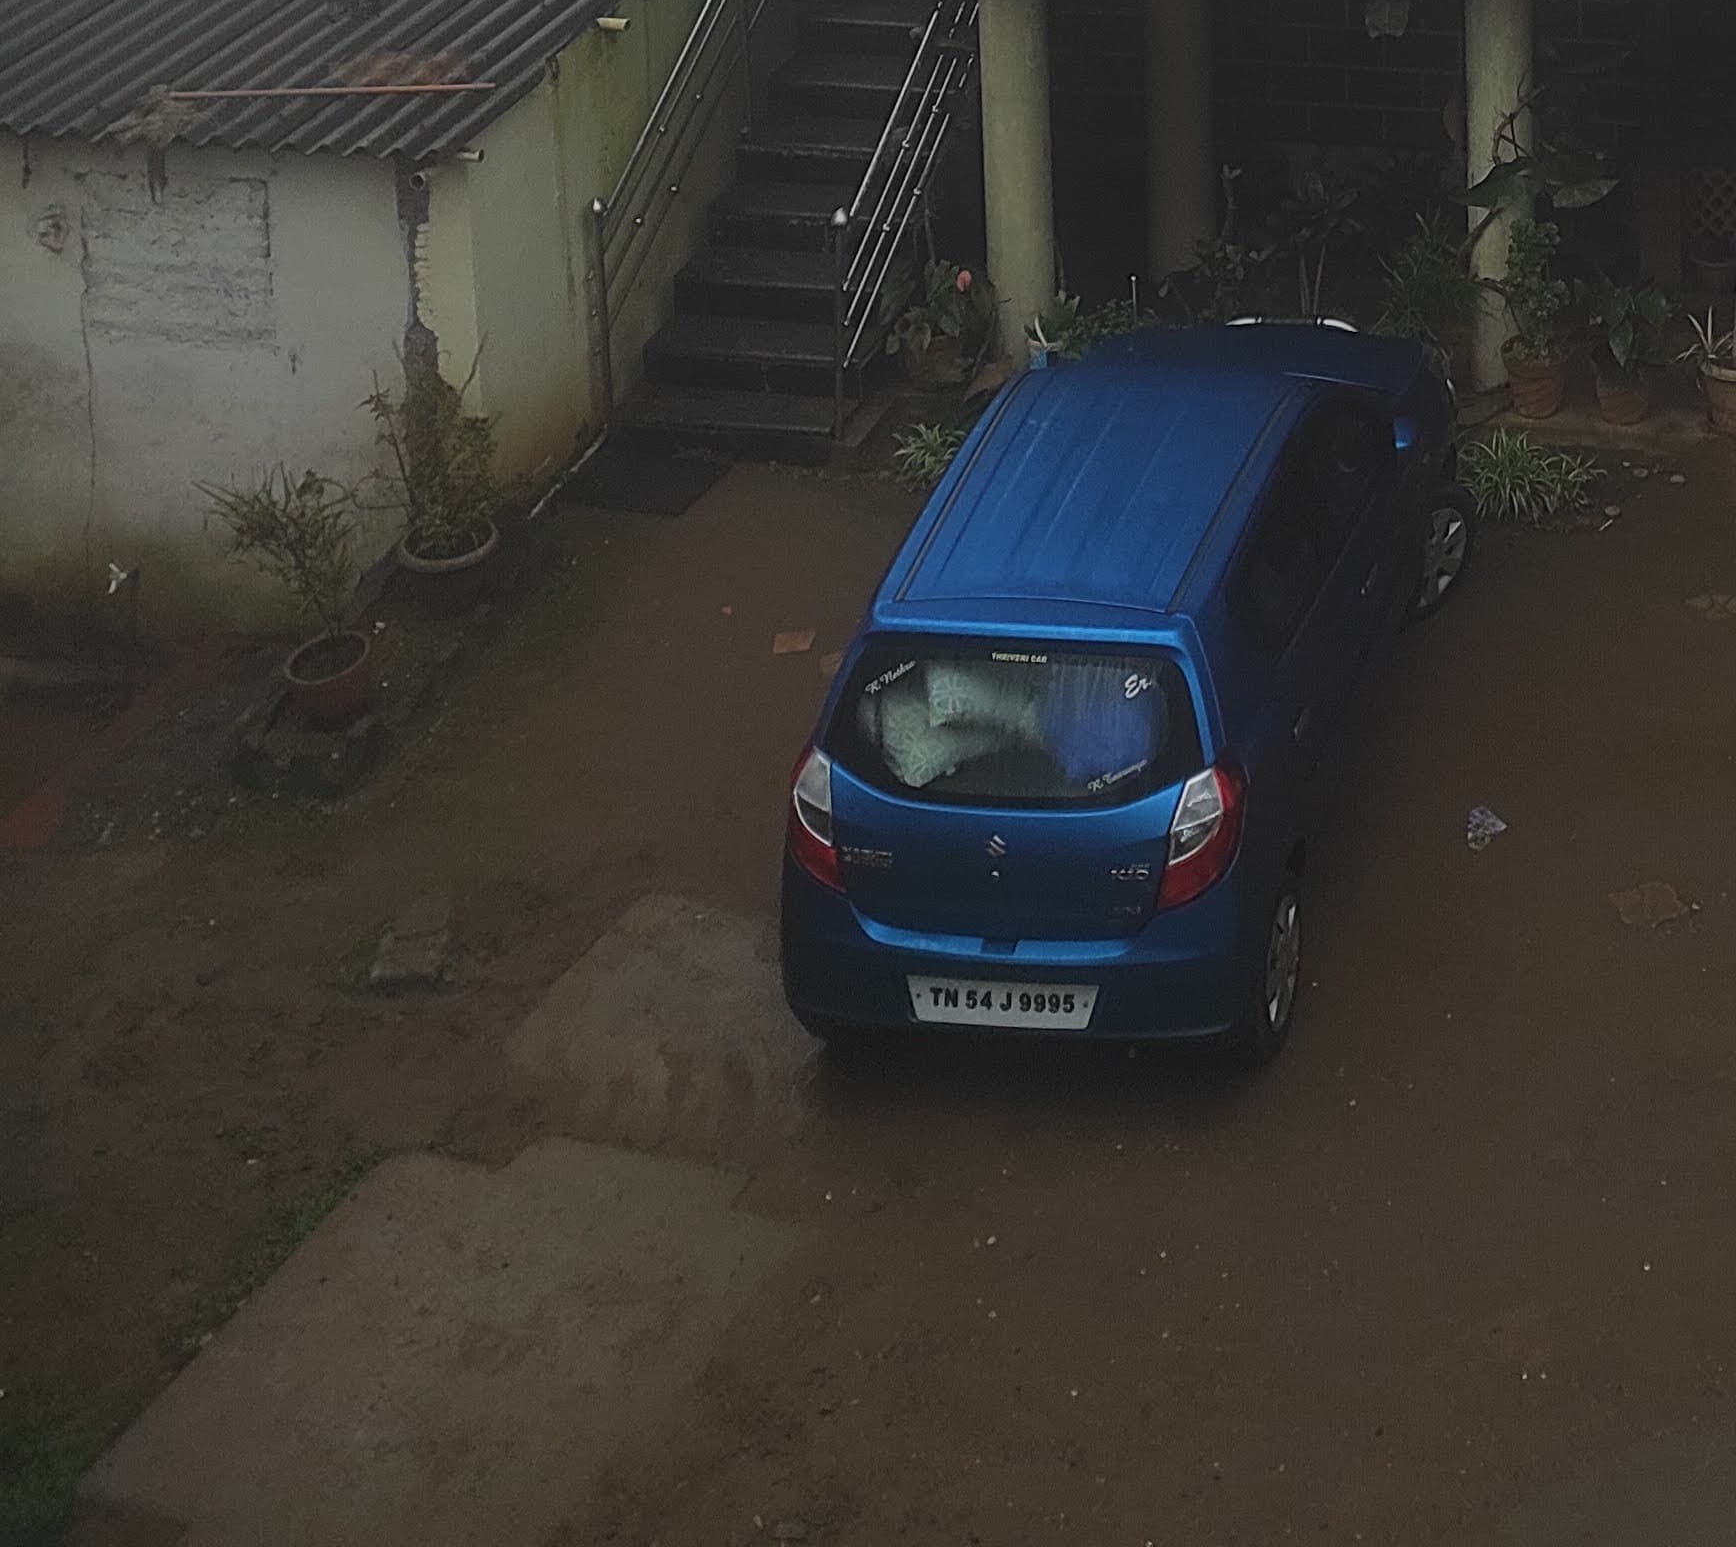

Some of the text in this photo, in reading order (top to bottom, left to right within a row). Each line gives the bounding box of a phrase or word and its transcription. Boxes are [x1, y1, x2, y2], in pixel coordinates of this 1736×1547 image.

[930, 987, 1075, 1014] TN 54 J 9995
